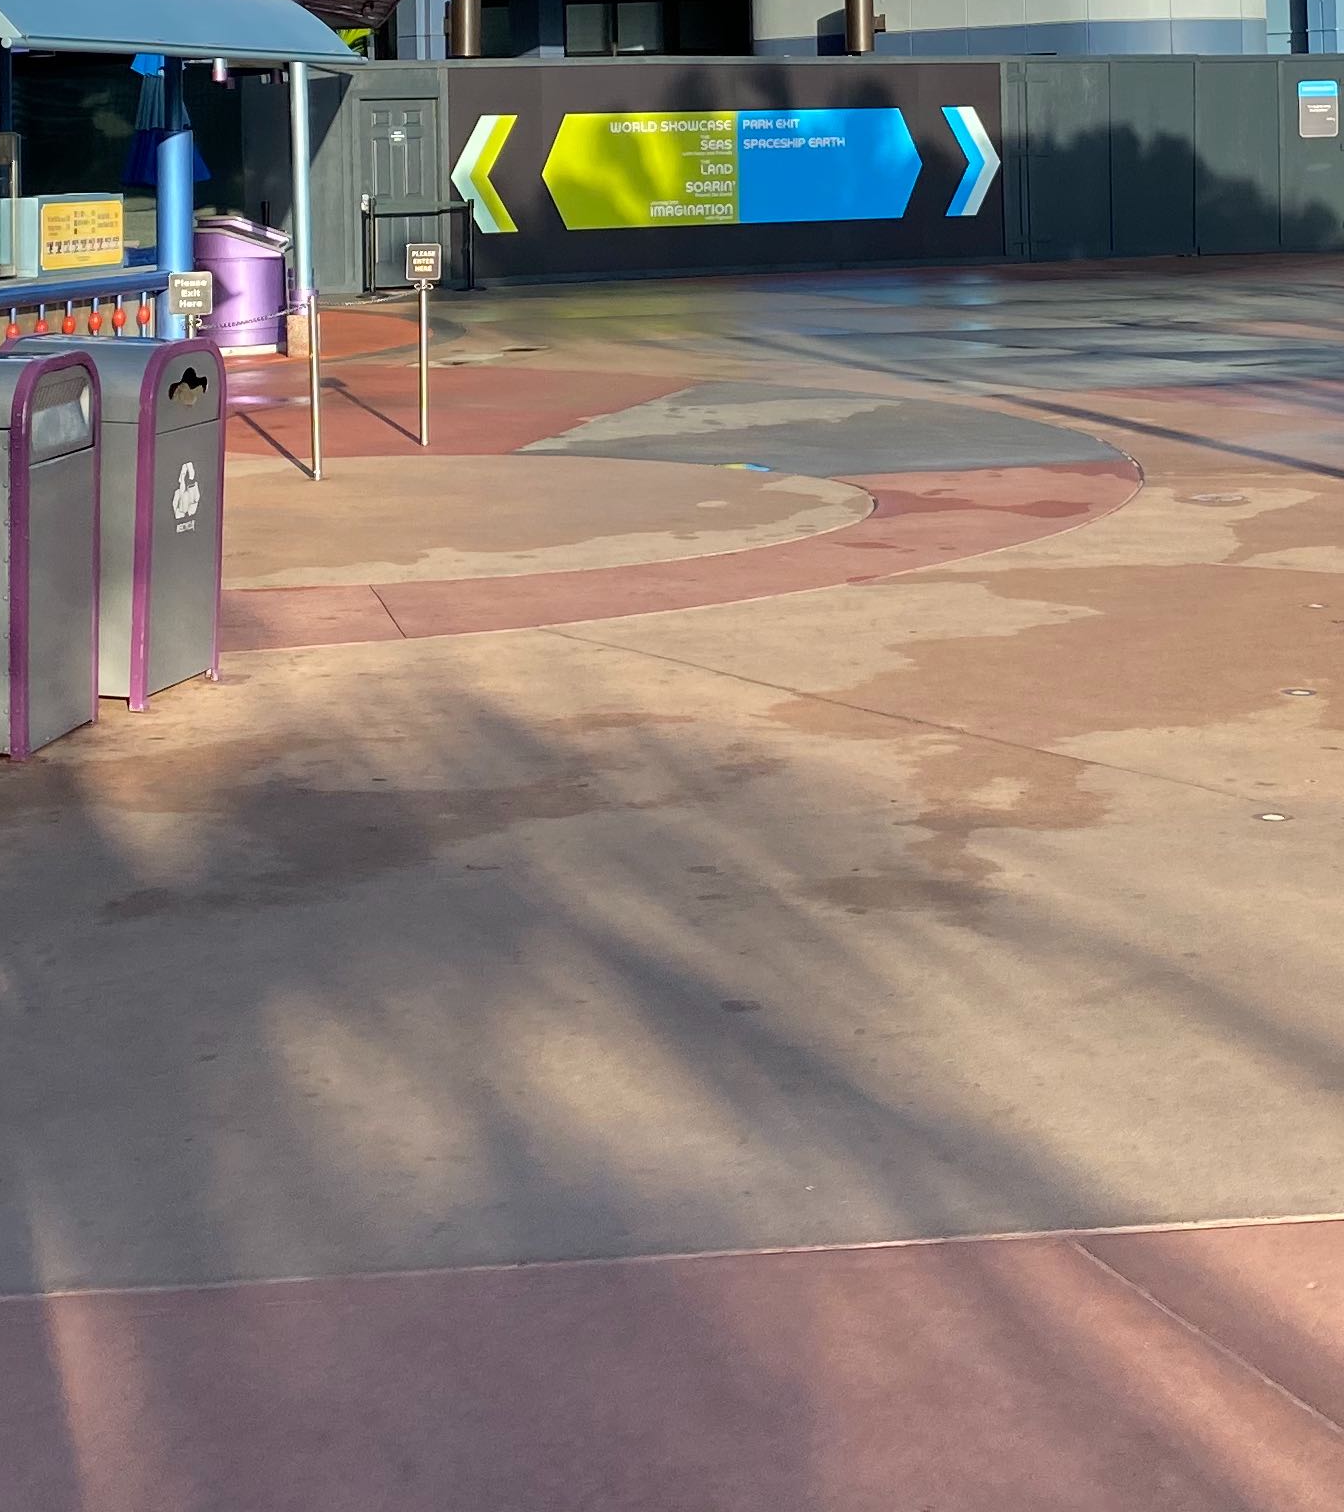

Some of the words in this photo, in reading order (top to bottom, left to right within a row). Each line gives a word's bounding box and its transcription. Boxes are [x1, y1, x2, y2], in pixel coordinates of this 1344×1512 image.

[609, 120, 657, 133] WORLD
[660, 119, 732, 132] SHOWCASE
[742, 119, 773, 130] PARK
[775, 118, 801, 129] EXIT
[700, 139, 733, 151] SEAS
[743, 137, 806, 150] SPACESHIP
[808, 136, 846, 148] EARTH
[700, 164, 733, 176] LAND
[685, 180, 736, 193] SOARIN'
[650, 203, 733, 217] IMAGINATION
[174, 279, 208, 287] Please
[180, 288, 201, 298] Exit
[178, 299, 203, 308] Here
